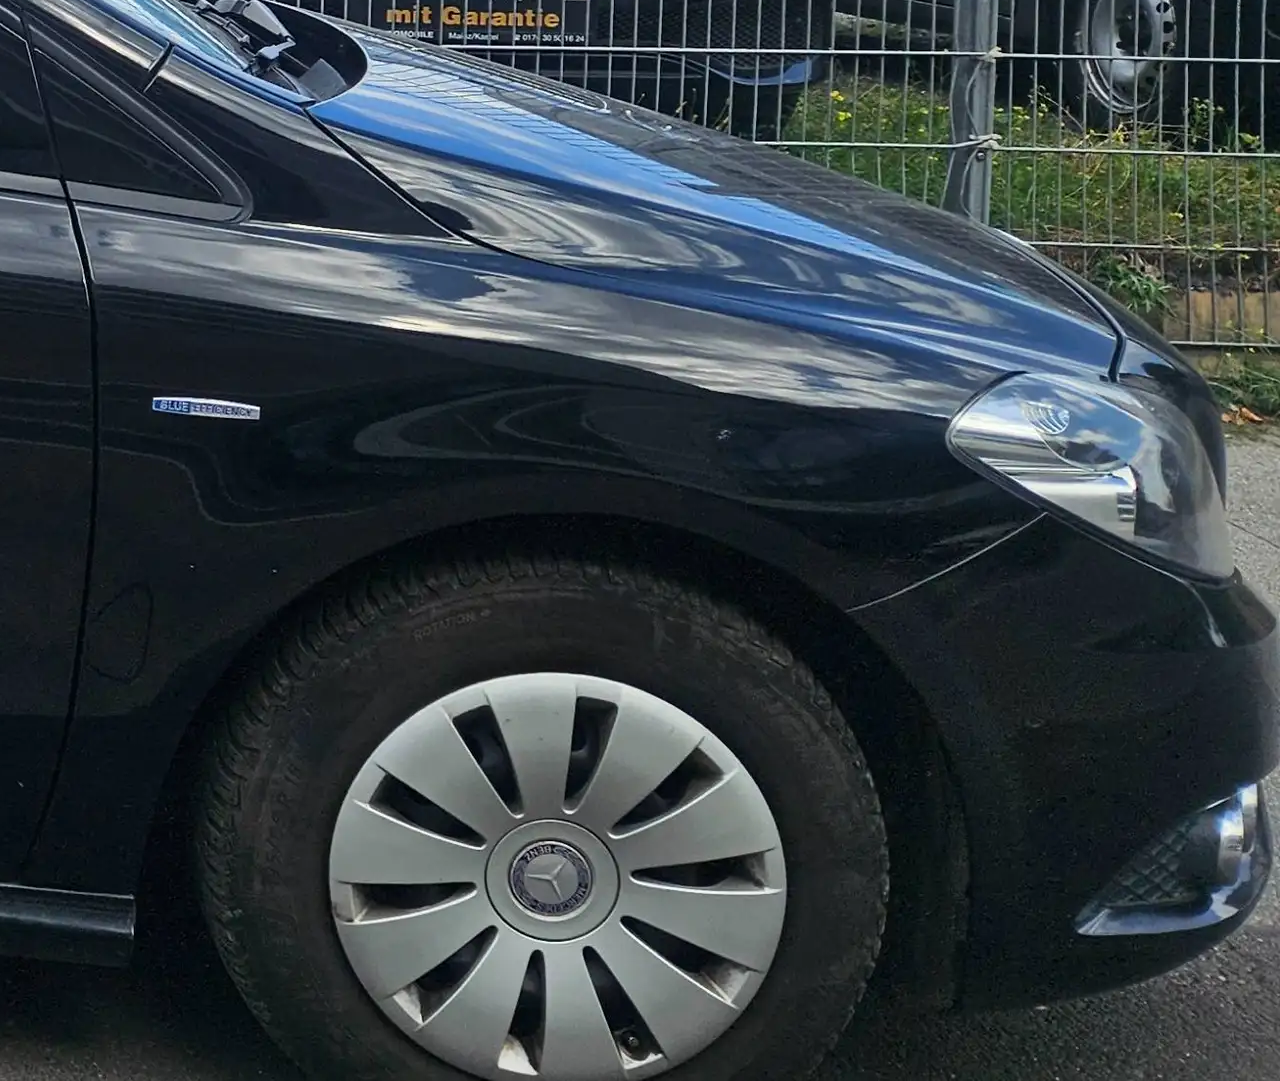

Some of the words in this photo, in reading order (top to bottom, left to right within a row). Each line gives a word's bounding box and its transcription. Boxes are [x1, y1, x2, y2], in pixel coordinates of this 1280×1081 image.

[386, 5, 432, 24] mit
[442, 6, 560, 28] Garantie
[160, 401, 189, 412] BLUE
